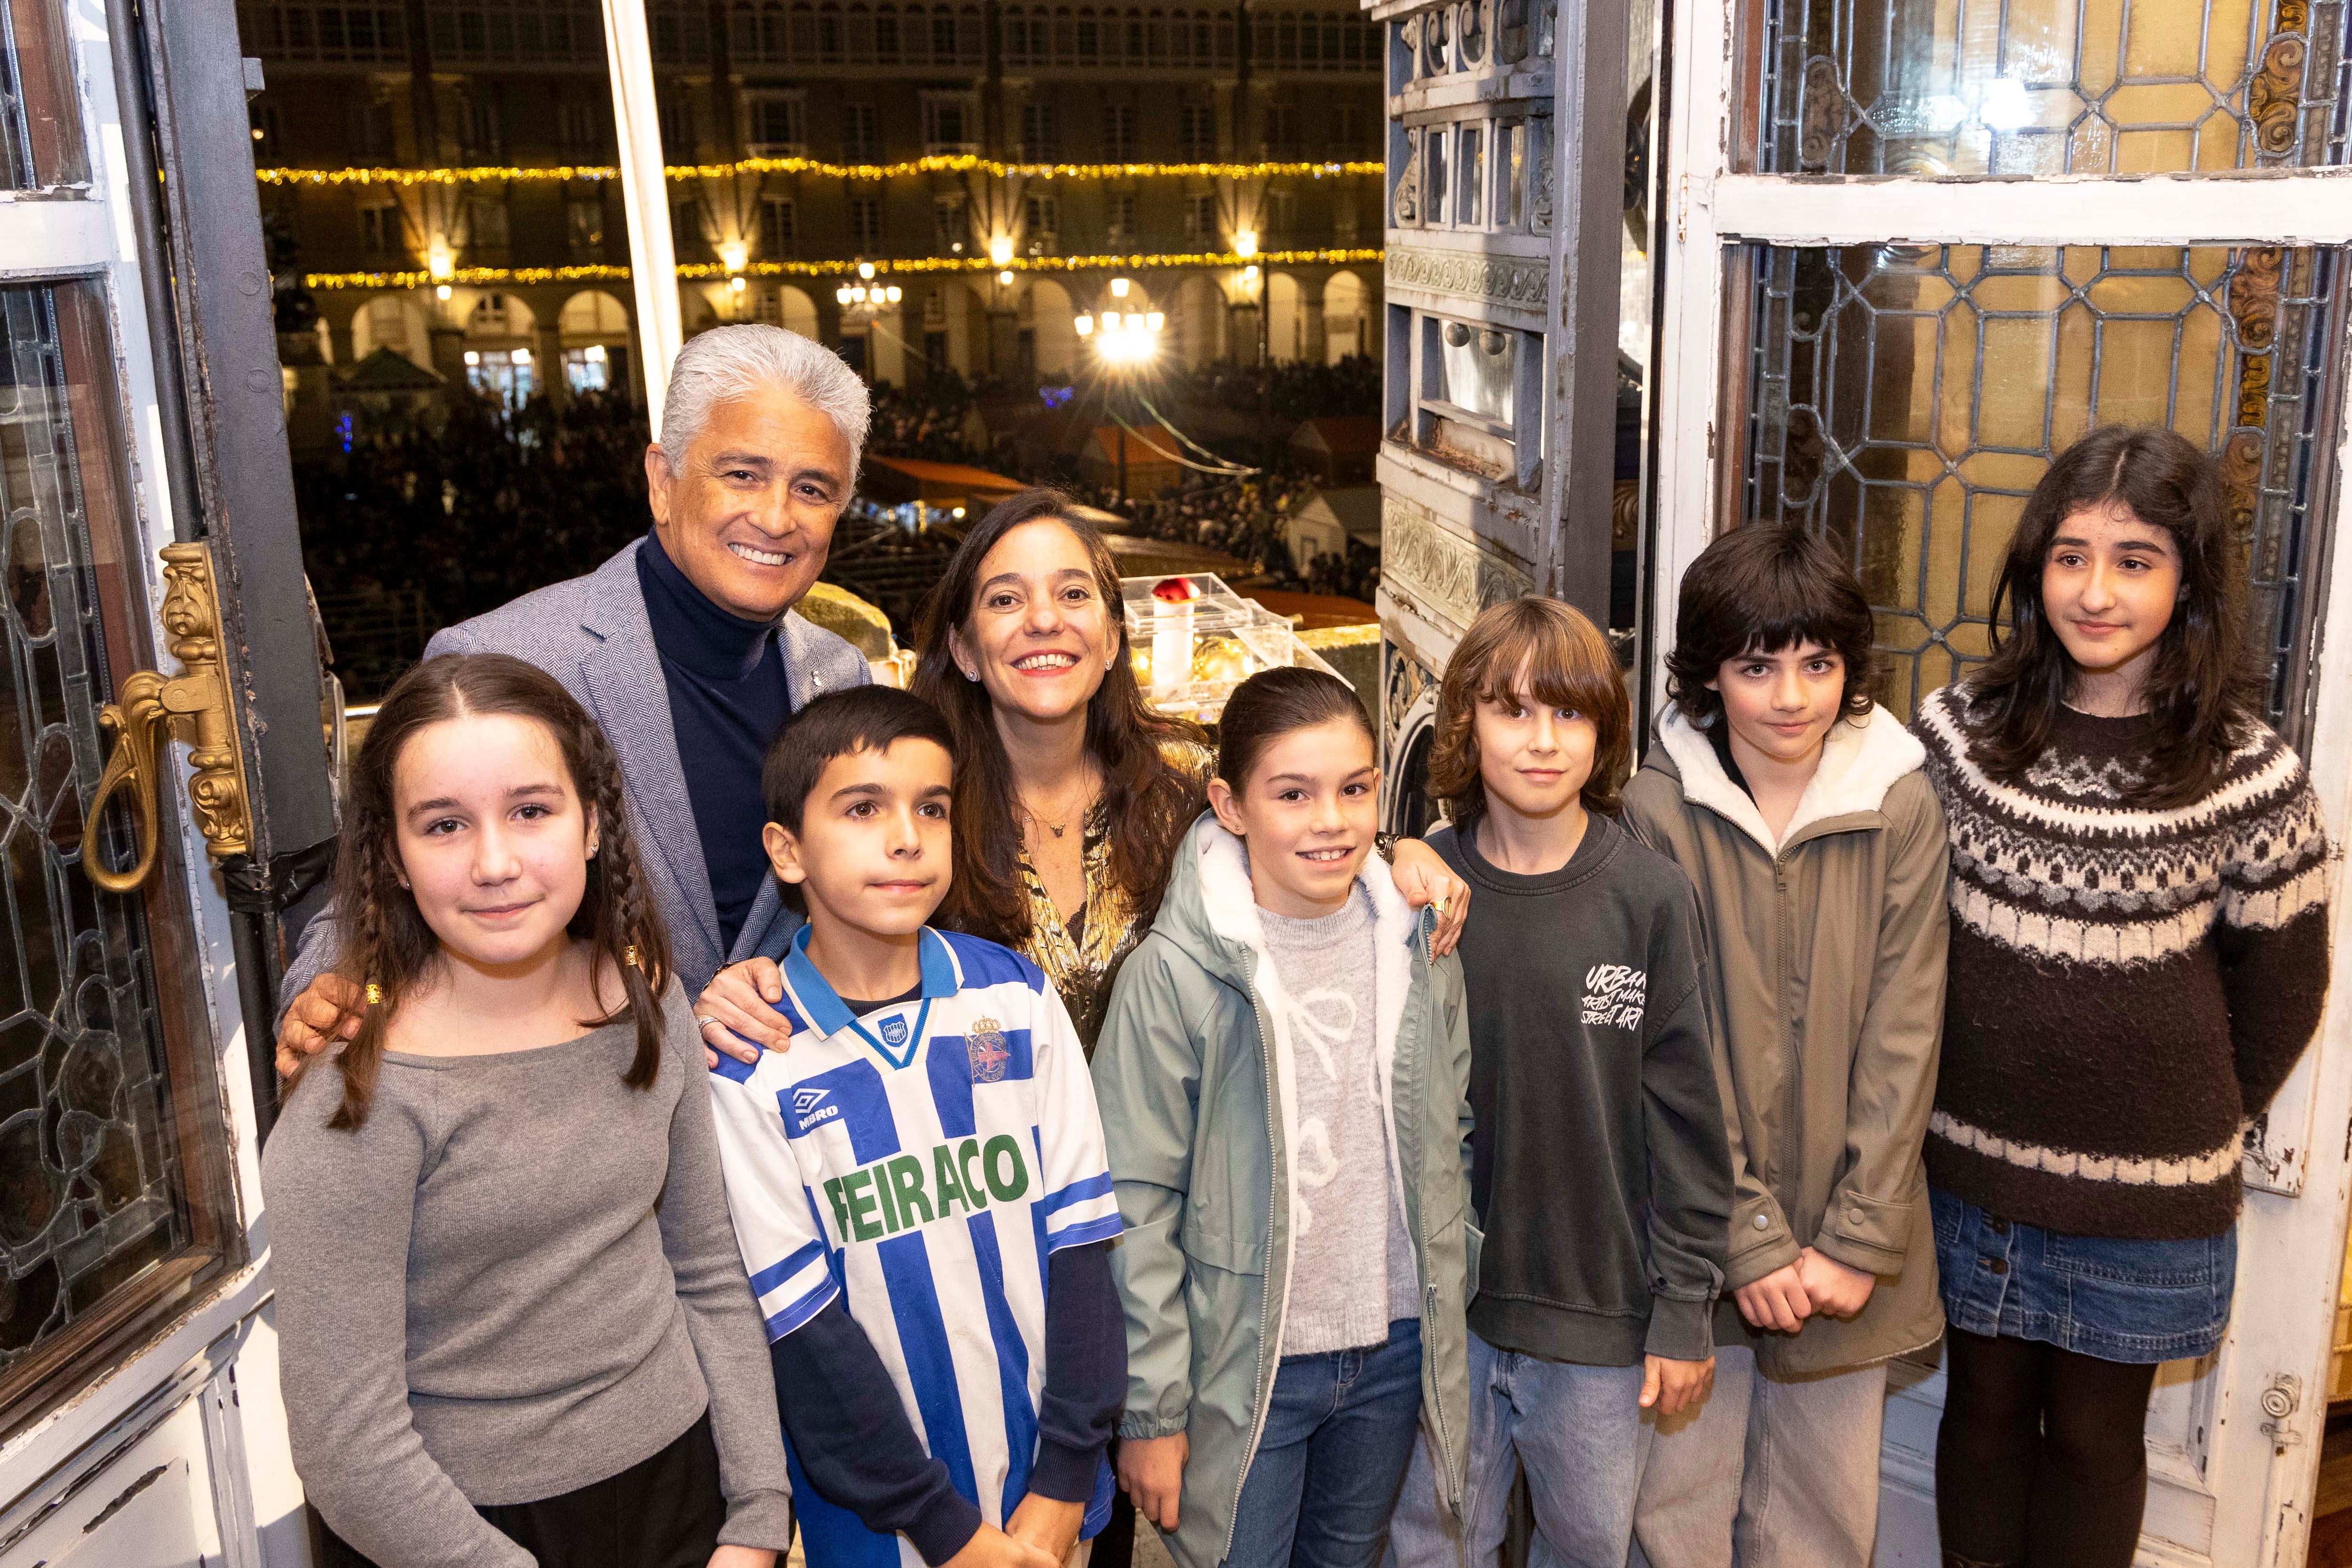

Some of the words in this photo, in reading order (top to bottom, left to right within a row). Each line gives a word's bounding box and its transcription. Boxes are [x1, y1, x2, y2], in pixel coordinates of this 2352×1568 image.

[1586, 963, 1646, 994] URBAN
[1581, 988, 1622, 1011] ARTIST
[1581, 1004, 1623, 1026] STREET
[1615, 1005, 1644, 1031] ART
[798, 1105, 839, 1131] MBRO
[823, 1134, 1029, 1243] FEIRACO
